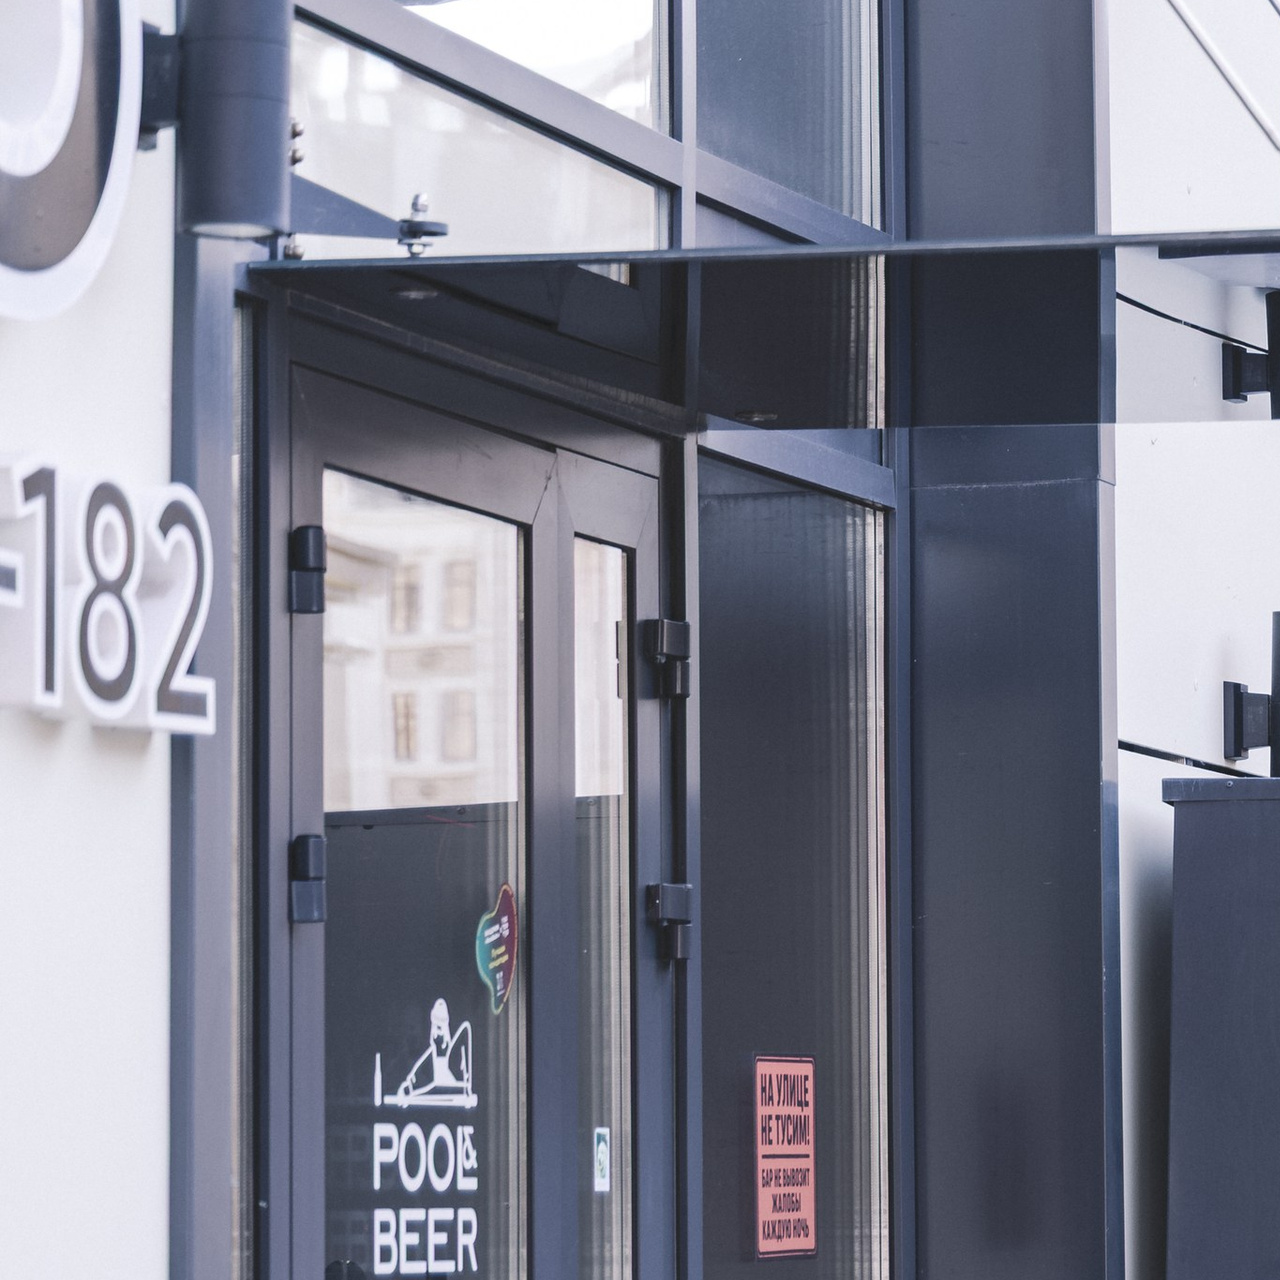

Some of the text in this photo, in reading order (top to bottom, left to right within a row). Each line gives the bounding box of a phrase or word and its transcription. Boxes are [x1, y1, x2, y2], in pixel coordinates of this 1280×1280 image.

[760, 1073, 810, 1112] НА УЛИЦЕ
[761, 1114, 810, 1146] НЕ ТУСИМ!
[373, 1122, 478, 1191] POOL&
[762, 1167, 810, 1188] БАР НЕ ВЫВОЗИТ
[771, 1192, 801, 1214] ЖАЛОБЫ
[373, 1207, 478, 1275] BEER
[762, 1217, 809, 1243] КАЖДУЮ НОЧЬ
